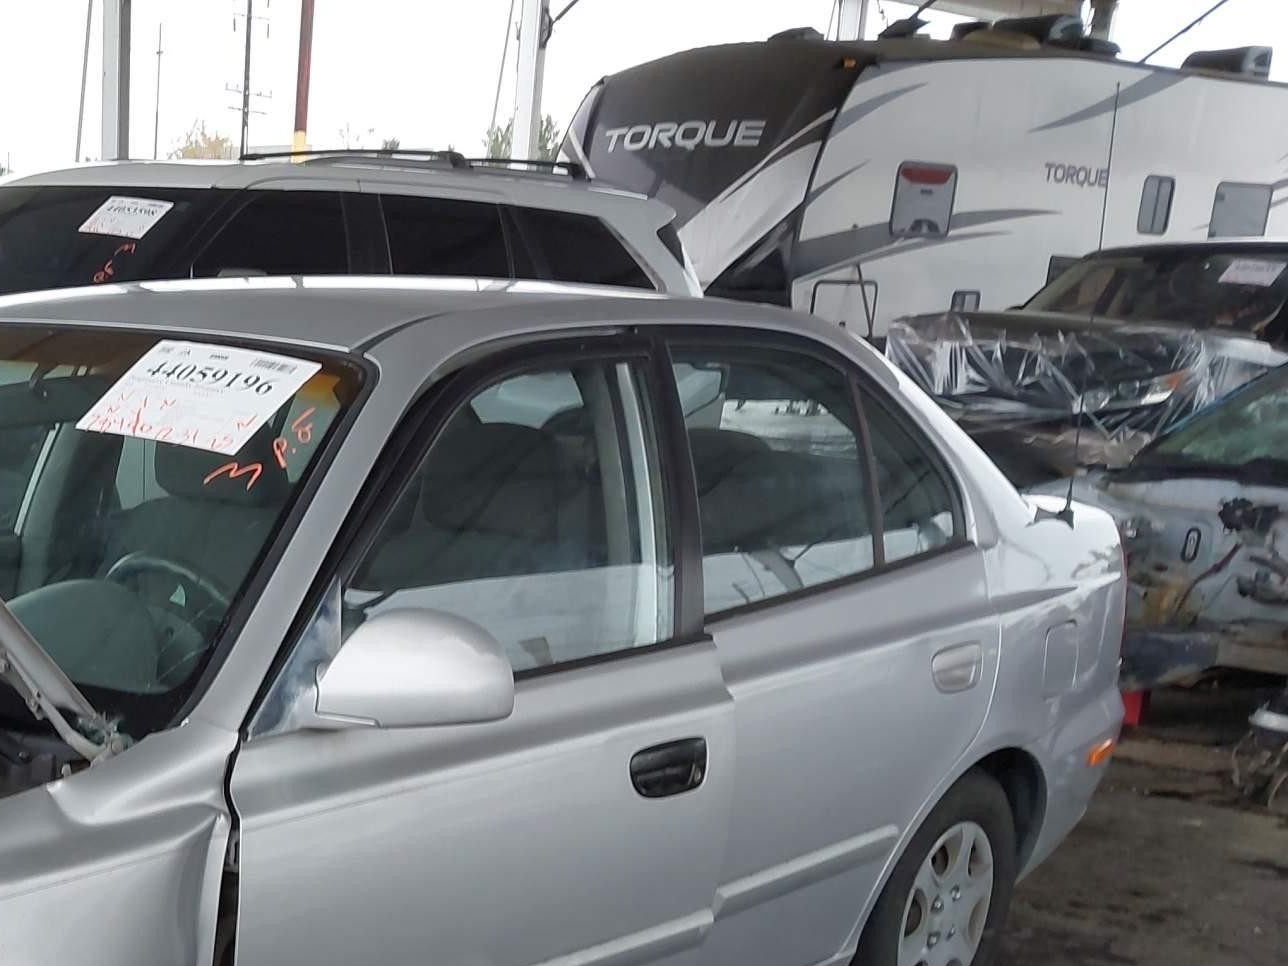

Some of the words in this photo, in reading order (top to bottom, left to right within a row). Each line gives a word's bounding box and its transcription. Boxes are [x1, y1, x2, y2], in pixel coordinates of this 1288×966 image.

[605, 119, 766, 153] TORQUE
[1044, 162, 1109, 188] TORQUE
[147, 361, 277, 395] 44059196
